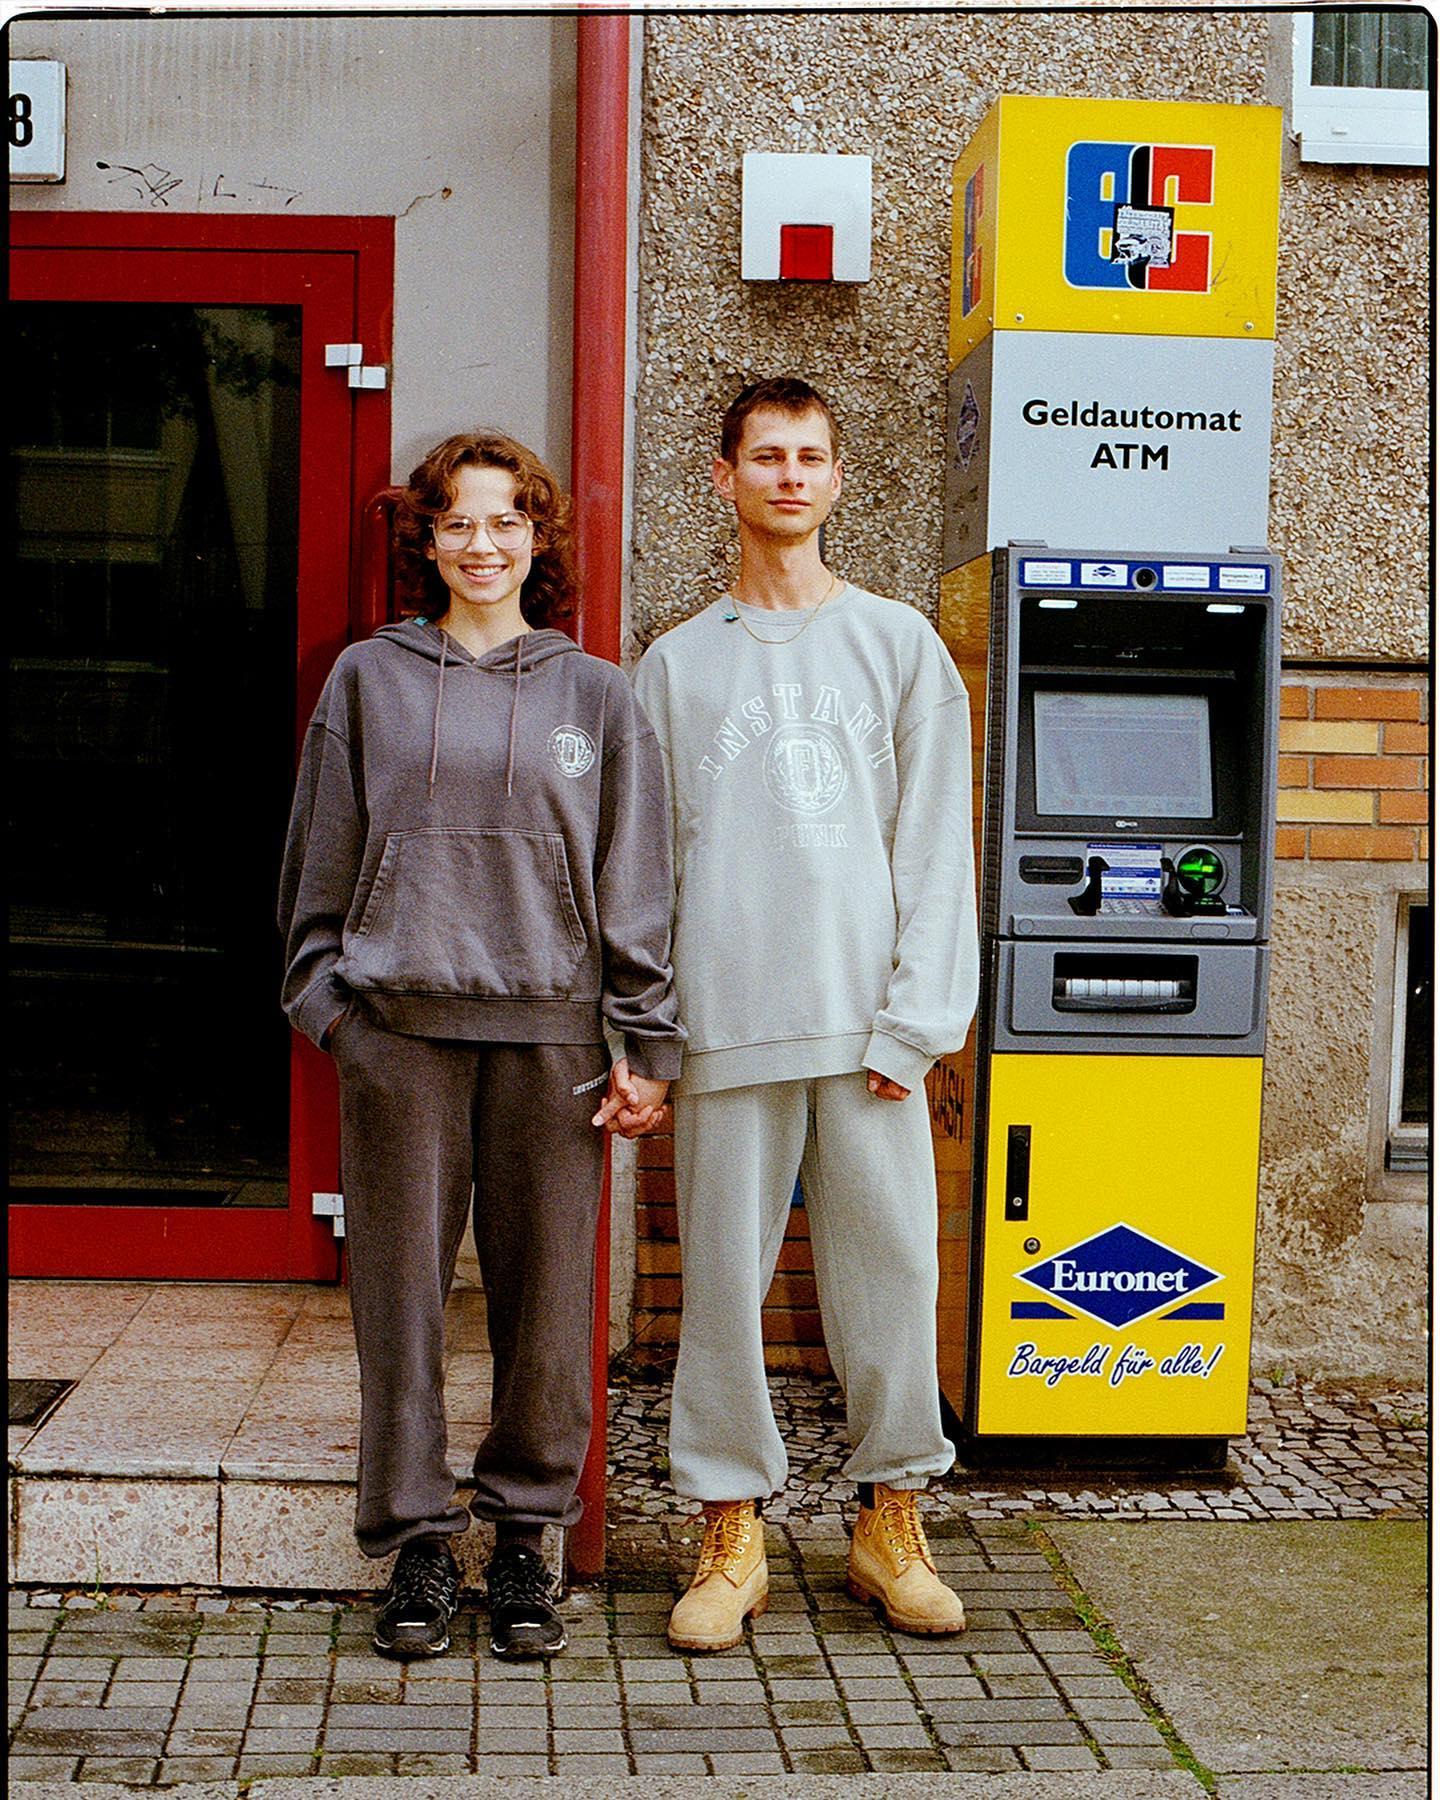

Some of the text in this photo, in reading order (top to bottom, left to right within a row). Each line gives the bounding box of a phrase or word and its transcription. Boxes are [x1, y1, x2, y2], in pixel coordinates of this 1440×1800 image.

[1022, 399, 1242, 431] Geldautomat
[1090, 443, 1169, 471] ATM
[1050, 1260, 1189, 1292] Euronet
[1009, 1343, 1224, 1385] Bargeld für alle!
